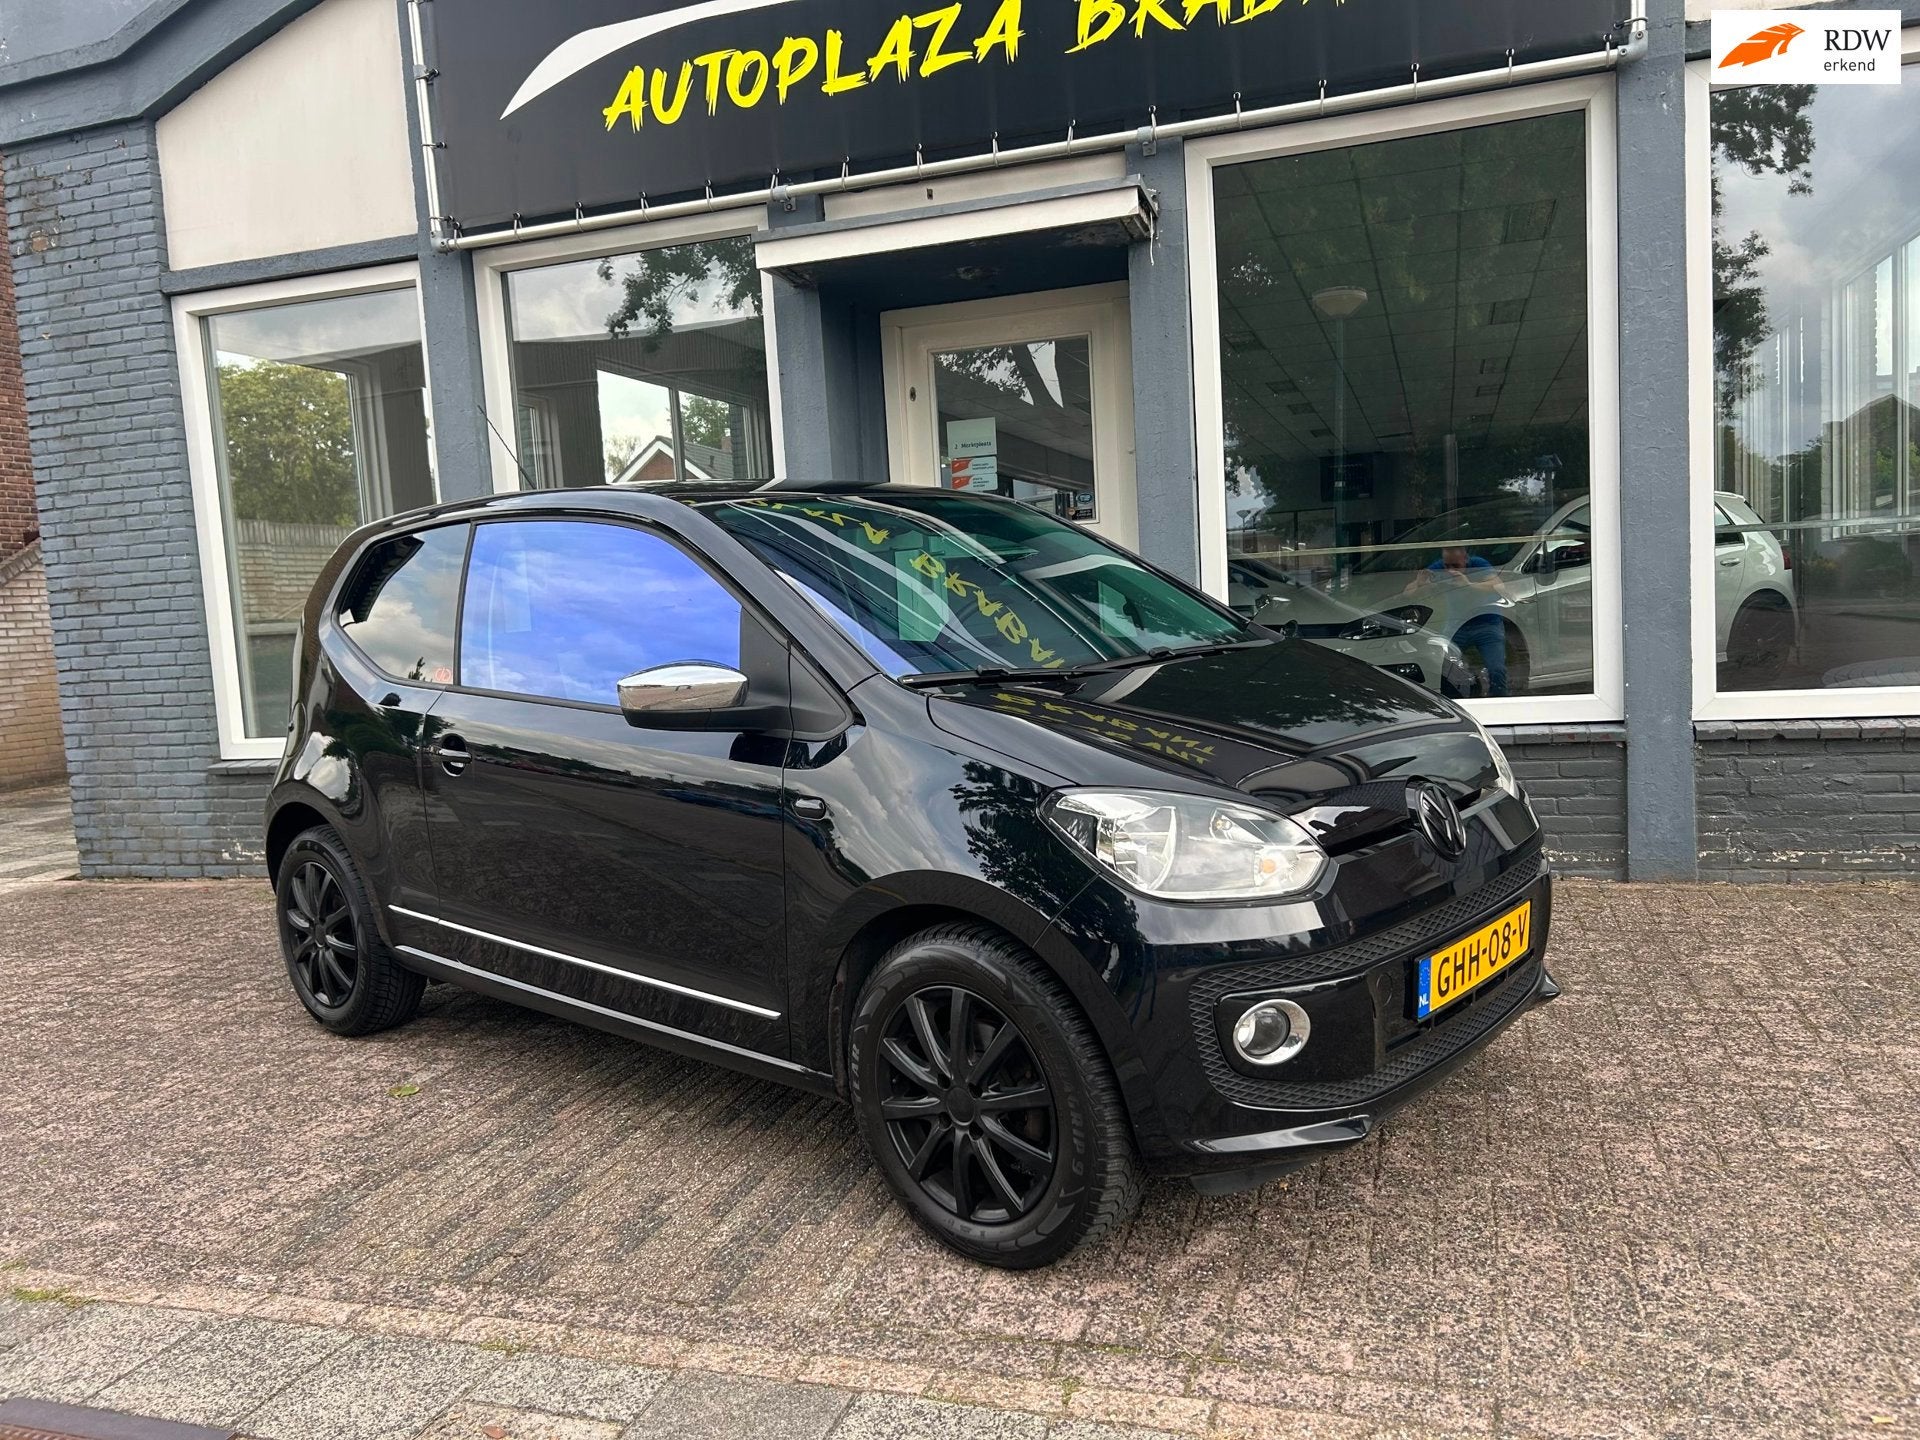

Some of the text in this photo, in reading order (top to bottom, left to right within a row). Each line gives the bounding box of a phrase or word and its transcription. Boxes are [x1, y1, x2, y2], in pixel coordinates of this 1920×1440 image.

[603, 0, 1026, 132] AUTOPLAZA
[1437, 909, 1529, 998] GHH-08-V
[1418, 994, 1429, 1008] NL
